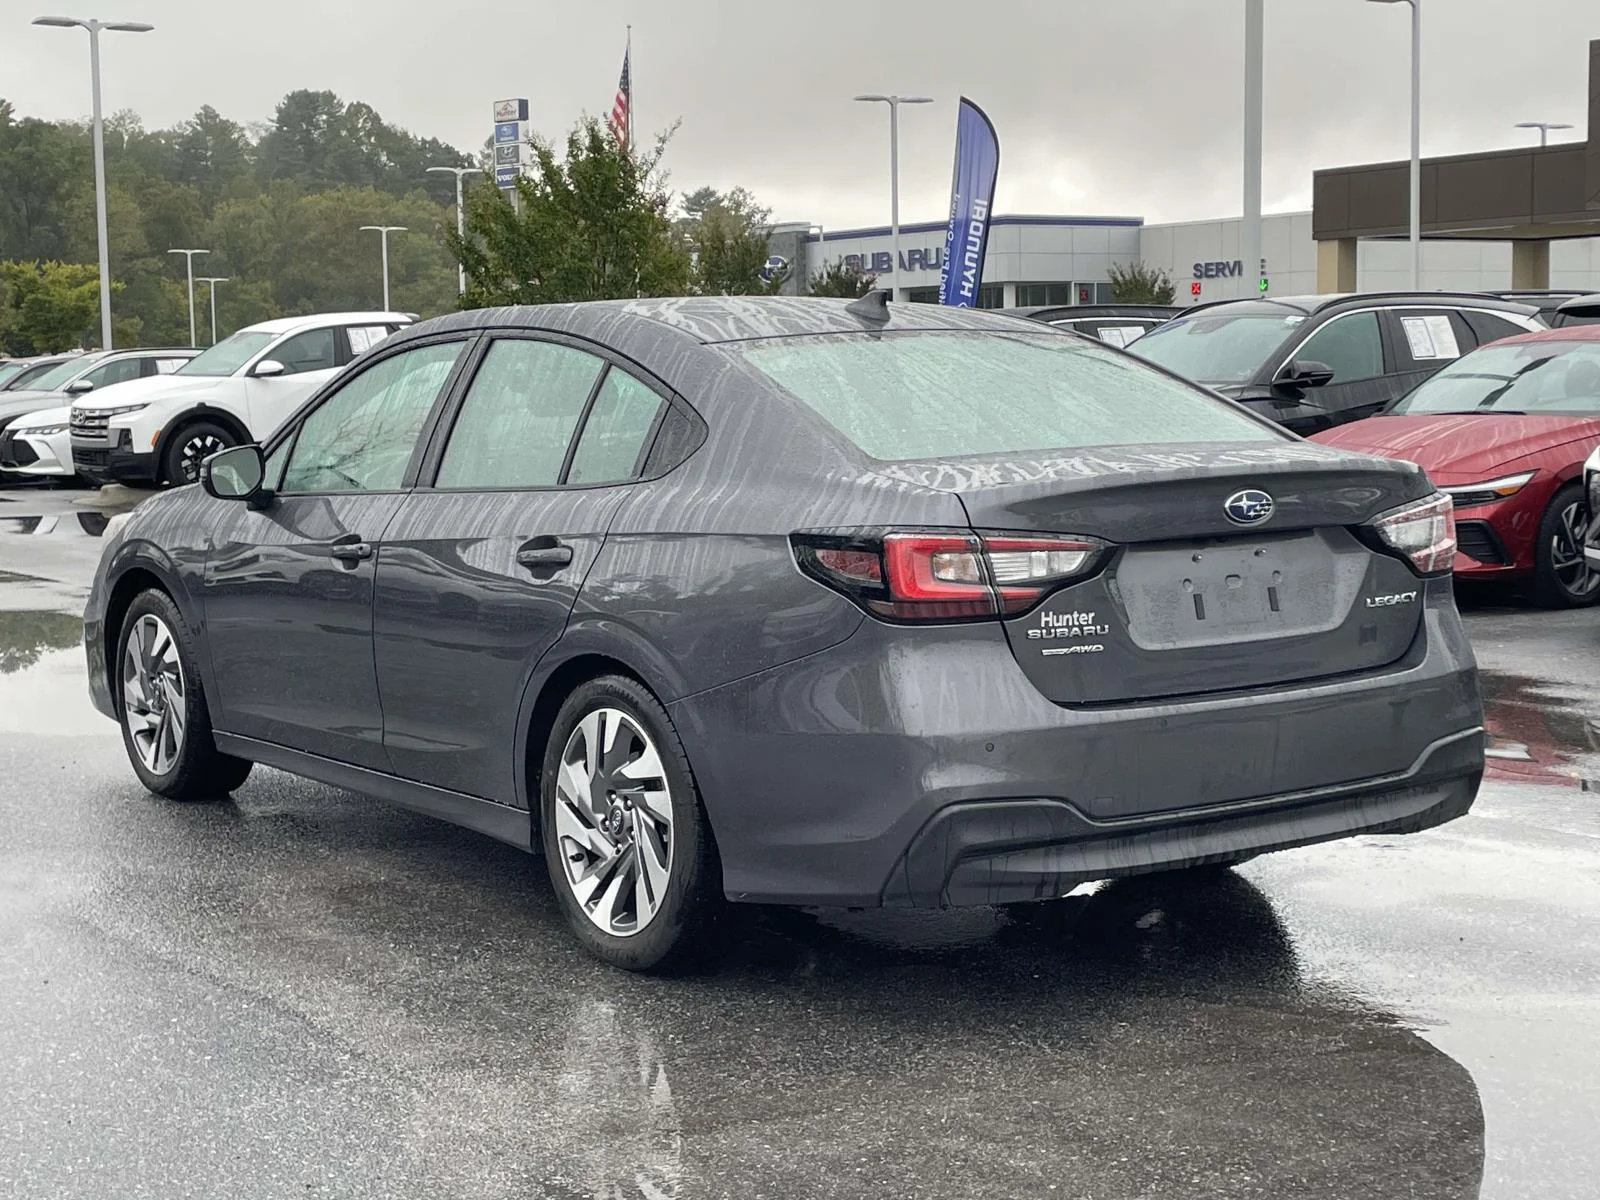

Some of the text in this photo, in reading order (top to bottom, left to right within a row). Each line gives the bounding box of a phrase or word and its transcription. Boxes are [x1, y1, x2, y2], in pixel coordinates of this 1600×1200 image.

[1366, 591, 1417, 607] LEGACY
[1040, 611, 1095, 627] Hunter
[1027, 625, 1109, 639] SUBARU
[1066, 644, 1104, 654] AWD
